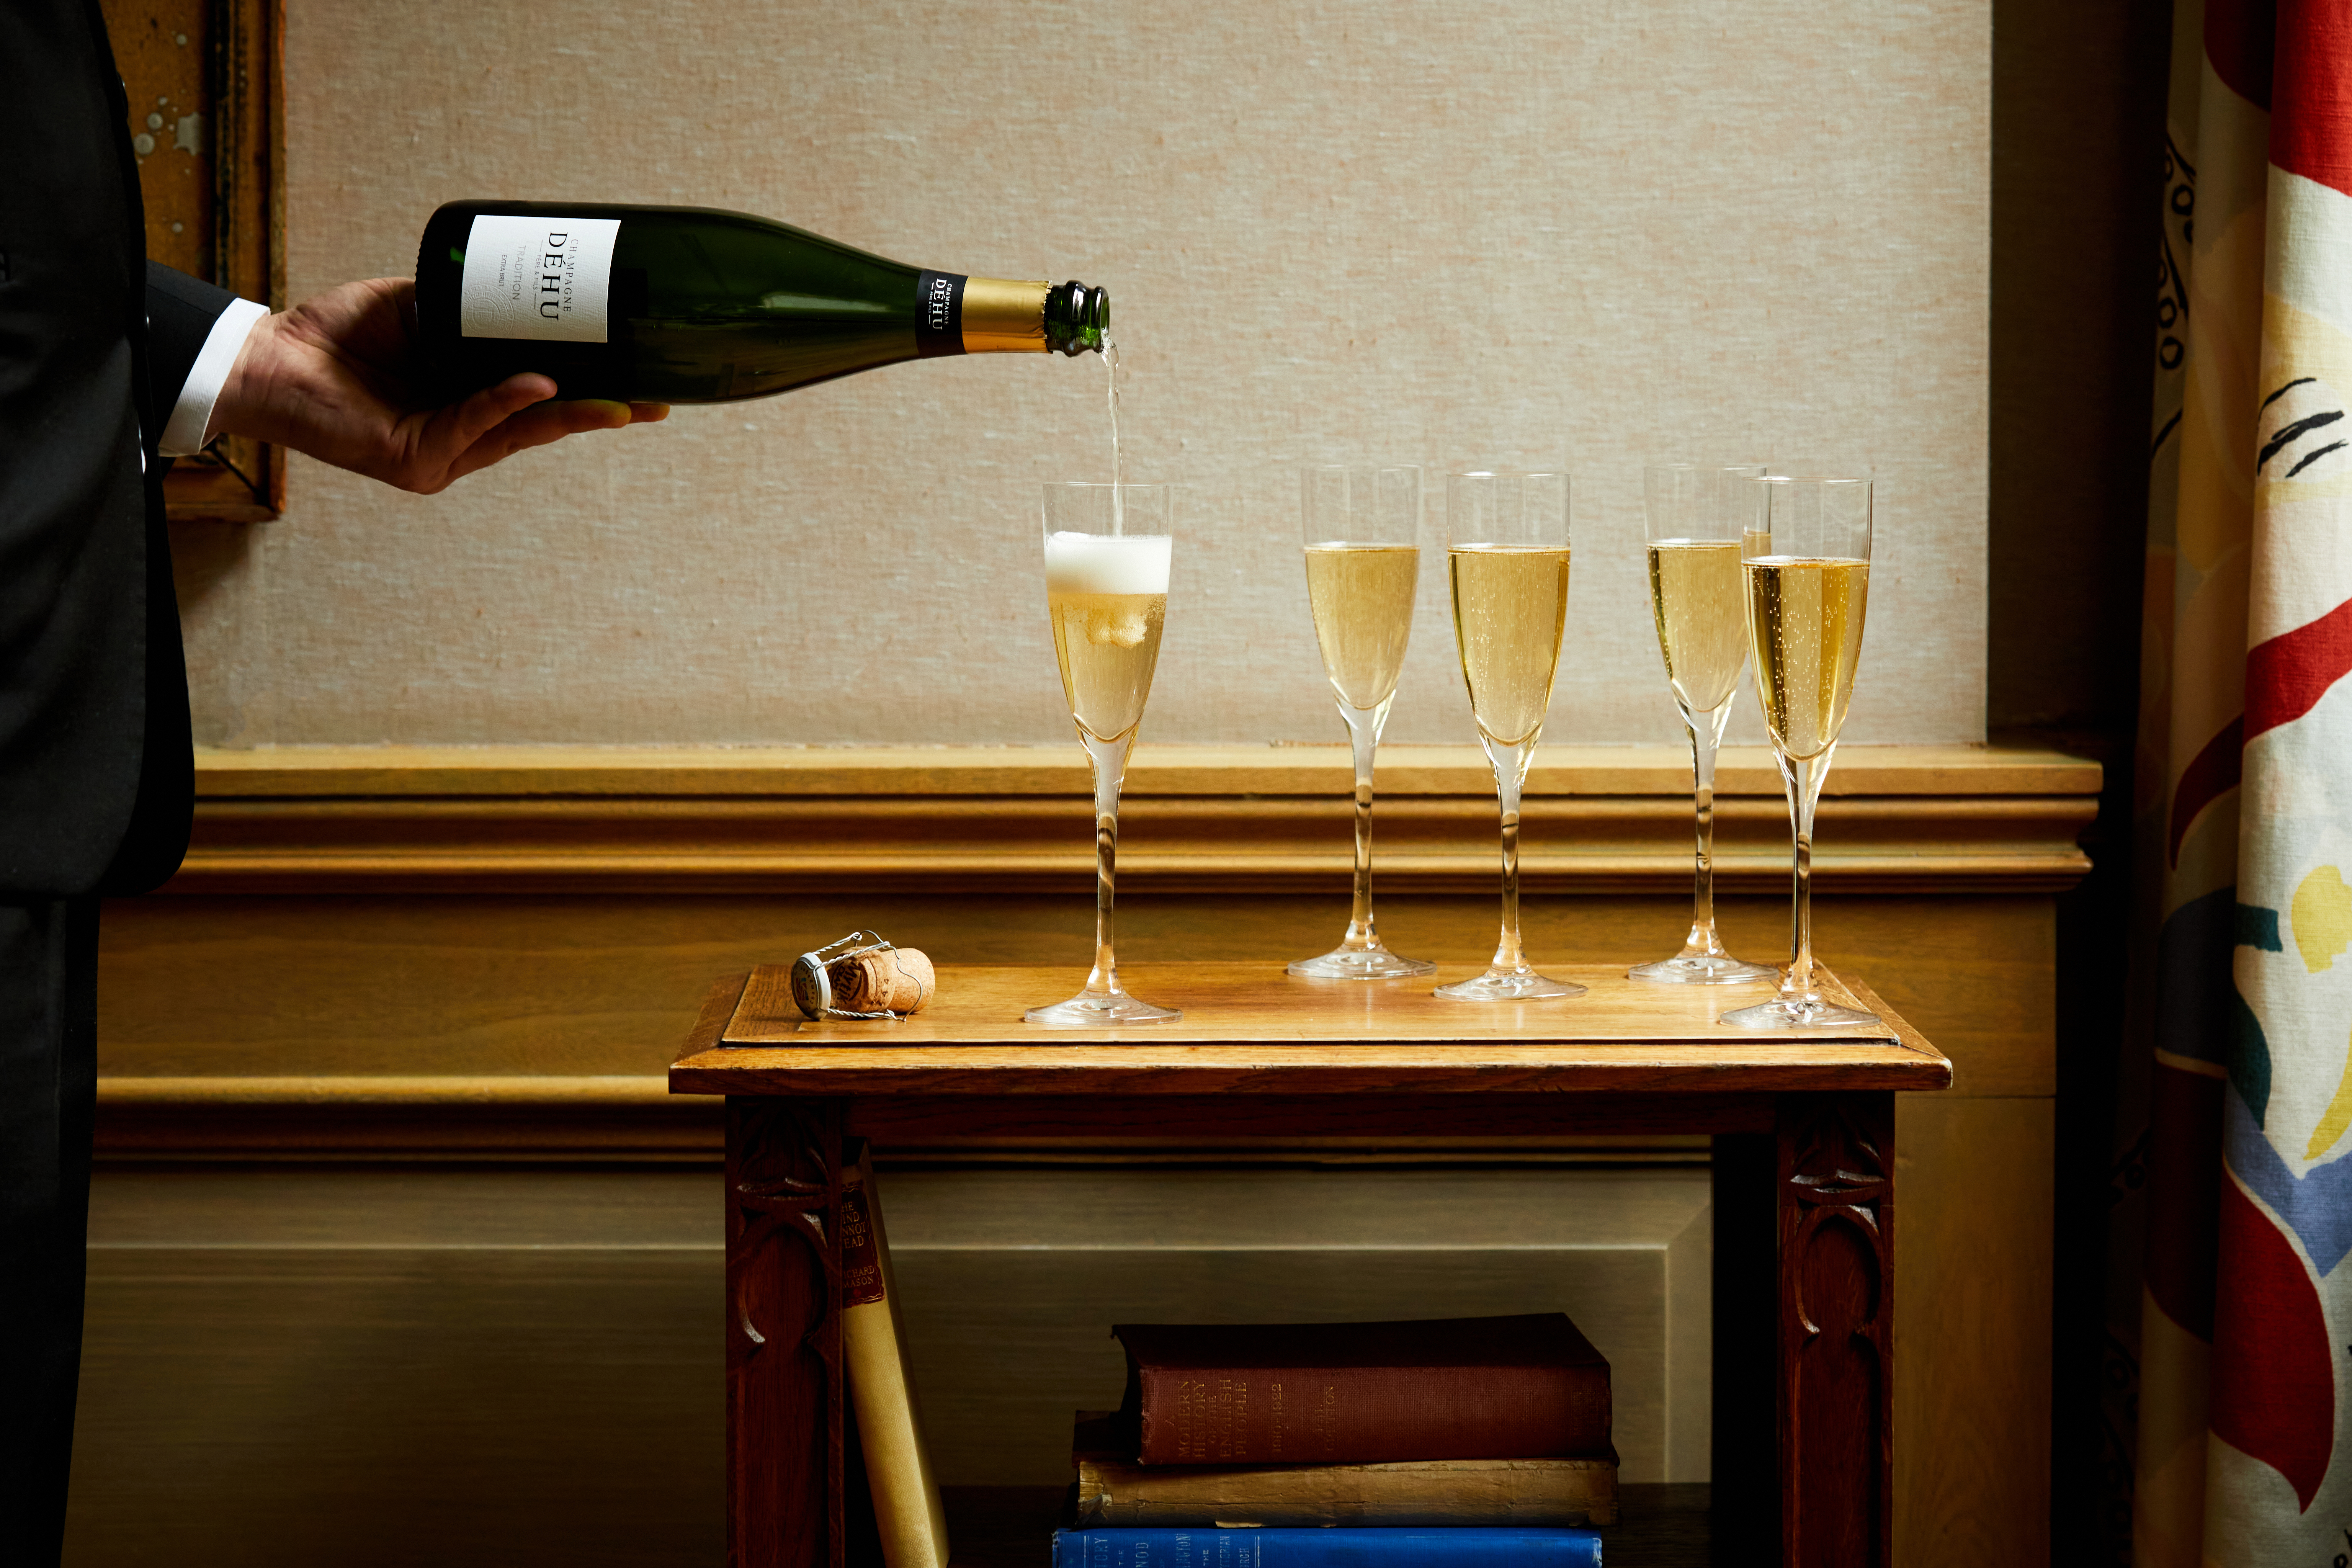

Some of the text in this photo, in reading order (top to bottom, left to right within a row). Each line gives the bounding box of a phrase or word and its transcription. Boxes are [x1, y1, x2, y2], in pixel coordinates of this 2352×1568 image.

[499, 273, 507, 287] BRUT
[512, 245, 526, 301] TRADITION
[540, 232, 569, 321] DÉHU
[563, 239, 579, 312] CHAMPAGNE
[932, 278, 947, 330] DÉHU
[944, 283, 952, 325] CHAMPAGNE
[842, 1202, 854, 1212] HE
[842, 1212, 860, 1224] IND
[842, 1221, 866, 1236] NNOT
[843, 1236, 864, 1248] EAD
[843, 1265, 875, 1279] ICHARD
[1178, 1381, 1190, 1457] MODERN
[1193, 1380, 1206, 1457] HISTORY
[1219, 1379, 1232, 1457] ENGLISH
[1235, 1382, 1247, 1454] PEOPLE
[1094, 1538, 1108, 1568] TORY
[1135, 1543, 1149, 1568] NOD
[1176, 1533, 1191, 1568] INGTON
[1219, 1536, 1230, 1568] YTERIAN
[1239, 1548, 1249, 1568] URCH
